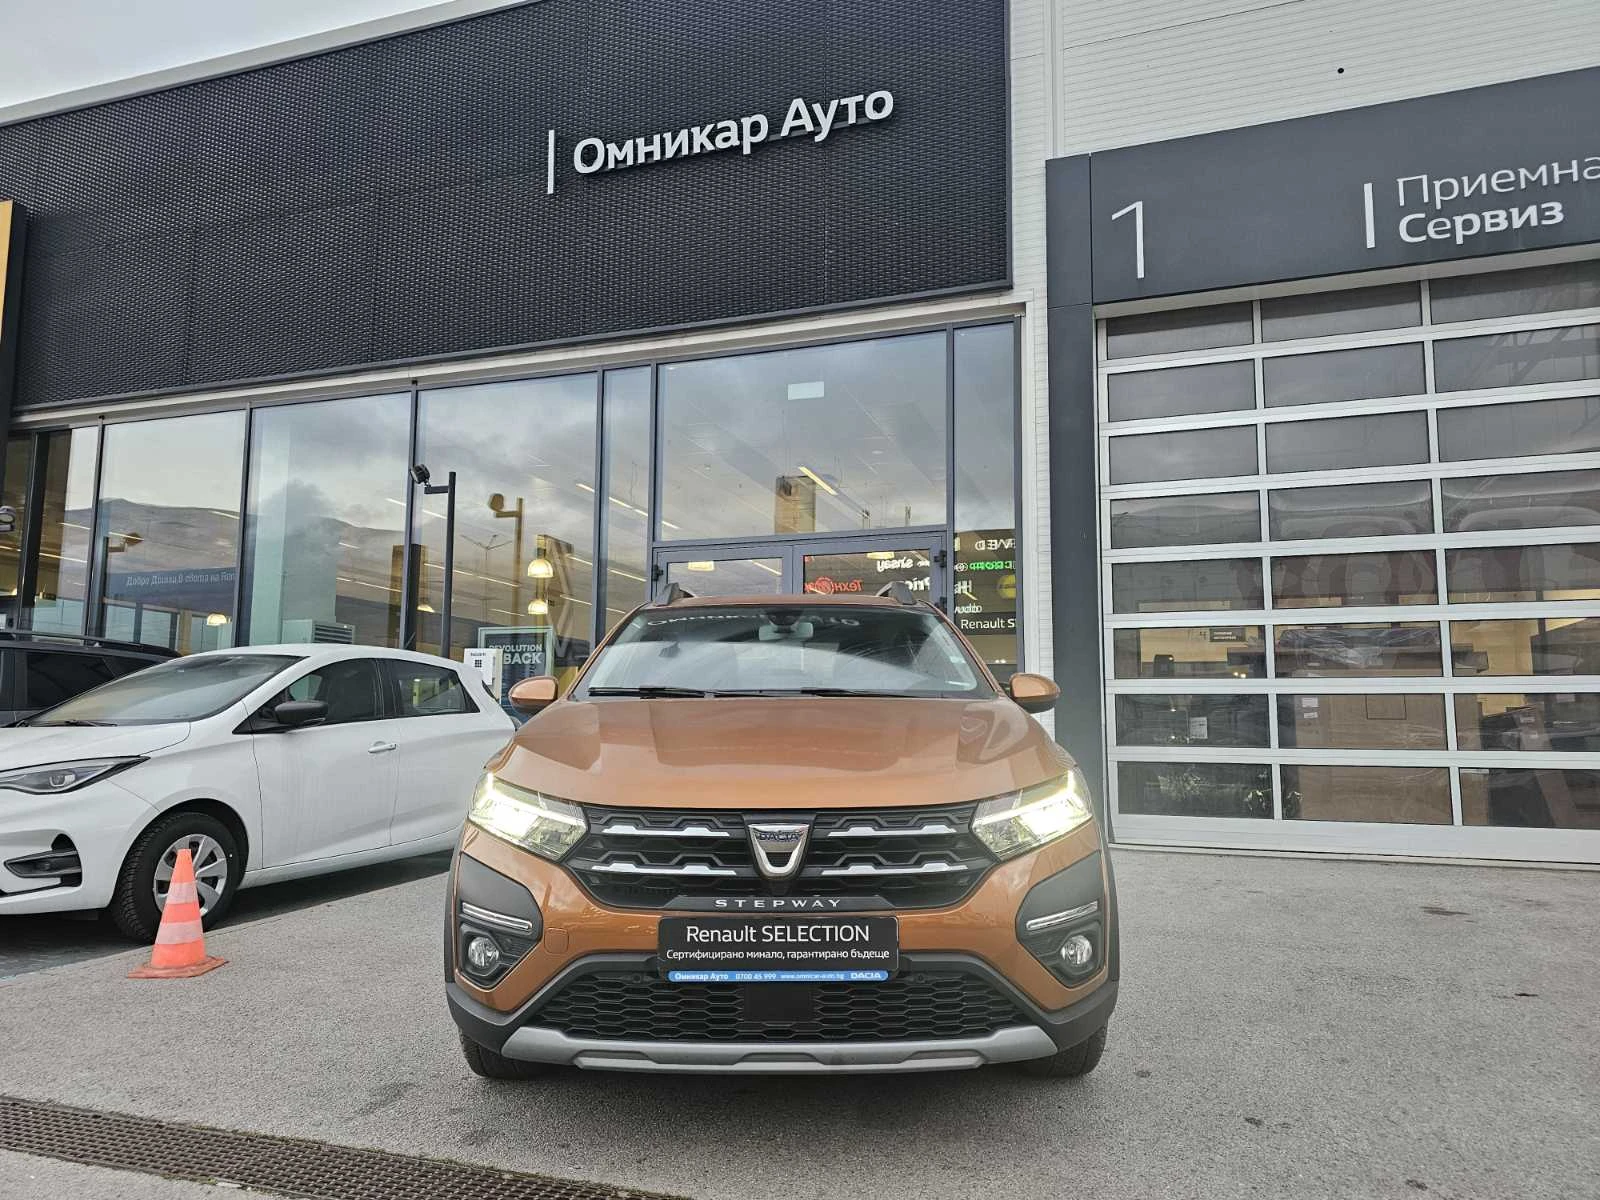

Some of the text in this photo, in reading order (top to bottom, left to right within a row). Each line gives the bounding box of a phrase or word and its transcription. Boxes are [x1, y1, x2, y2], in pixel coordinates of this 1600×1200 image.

[573, 90, 894, 174] Омникар Ауто
[1397, 156, 1600, 210] Приемна
[1399, 201, 1564, 245] Сервиз
[1111, 201, 1144, 279] 1
[960, 617, 1005, 629] Renault
[503, 653, 543, 664] BACK
[758, 830, 800, 842] DACIA
[715, 899, 841, 908] STEPWAY
[686, 925, 870, 942] Renault SELECTION
[666, 949, 890, 961] Сертифицирано минало, гарантирано бъдеще
[710, 972, 729, 981] Ауто
